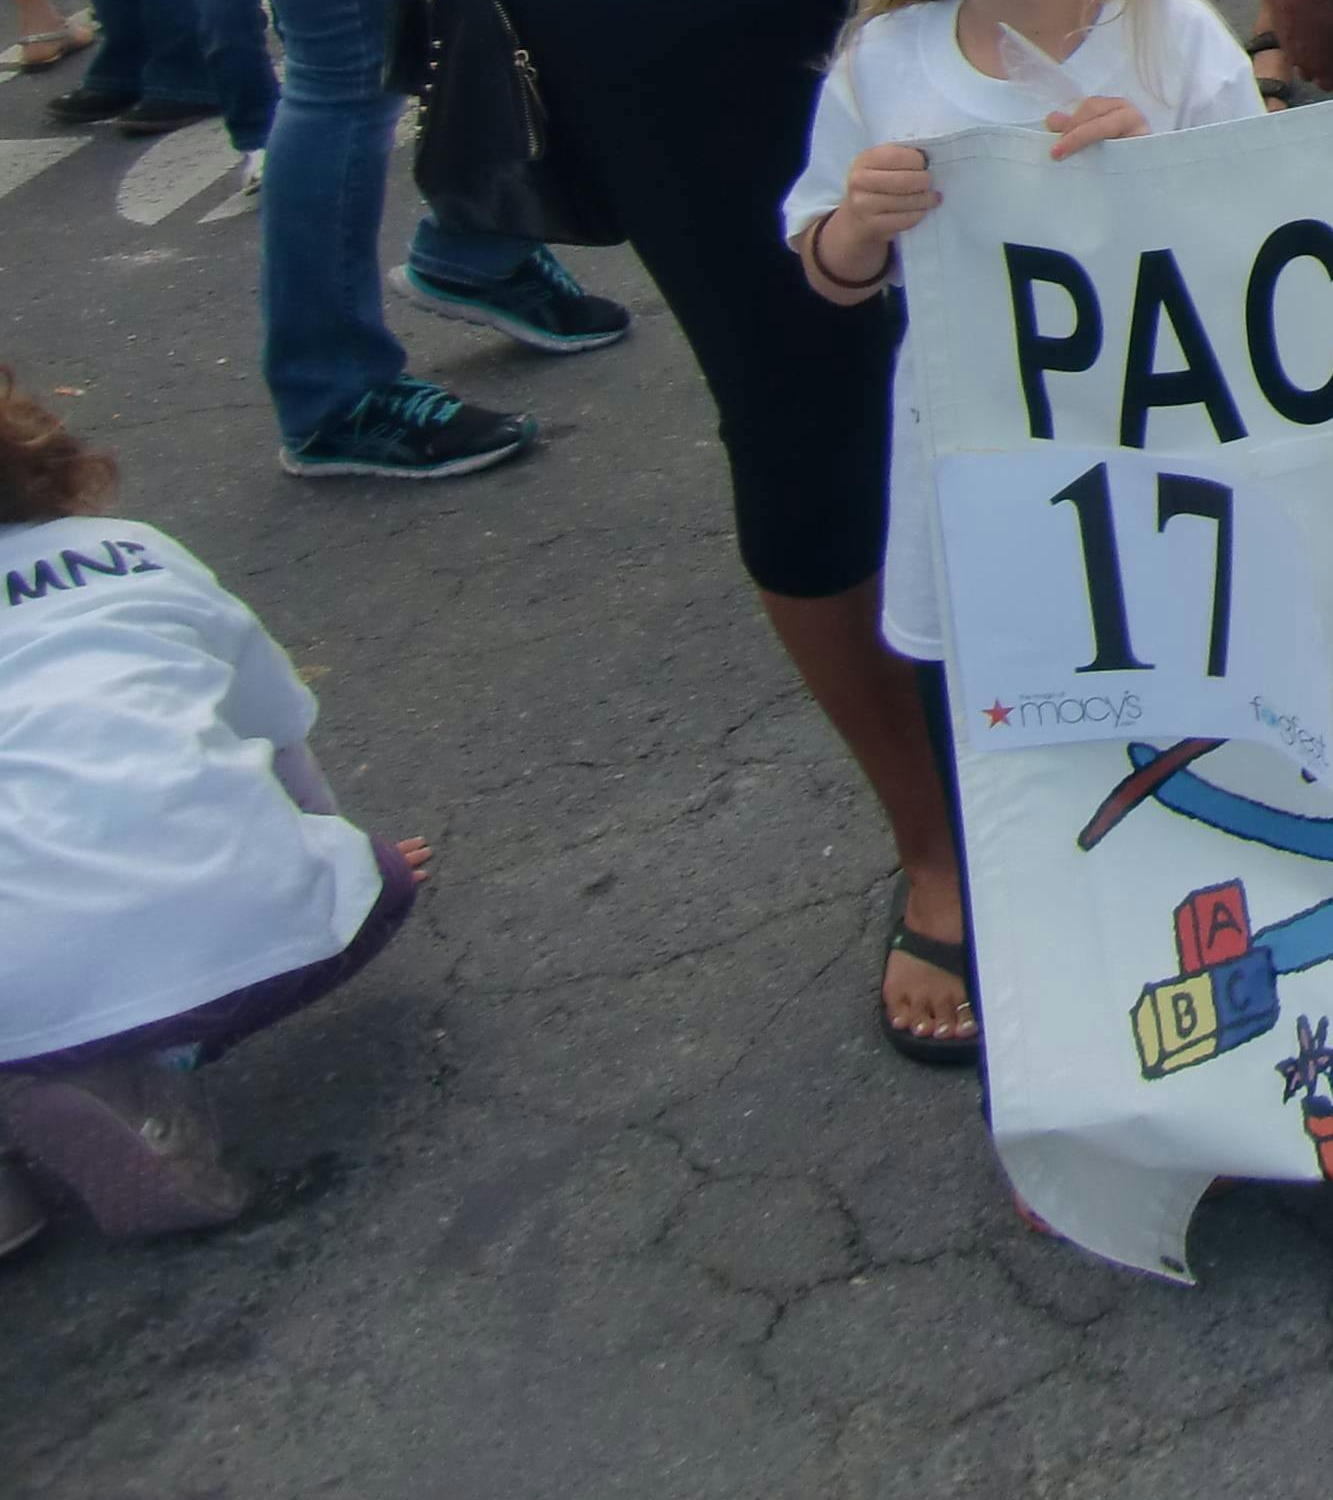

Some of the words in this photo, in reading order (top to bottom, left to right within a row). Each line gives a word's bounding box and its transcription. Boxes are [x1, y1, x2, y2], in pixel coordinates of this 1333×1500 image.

[1049, 461, 1235, 678] 17
[1020, 691, 1143, 728] macy's
[1207, 901, 1242, 949] A
[1172, 992, 1198, 1038] B
[1228, 969, 1250, 1012] C
